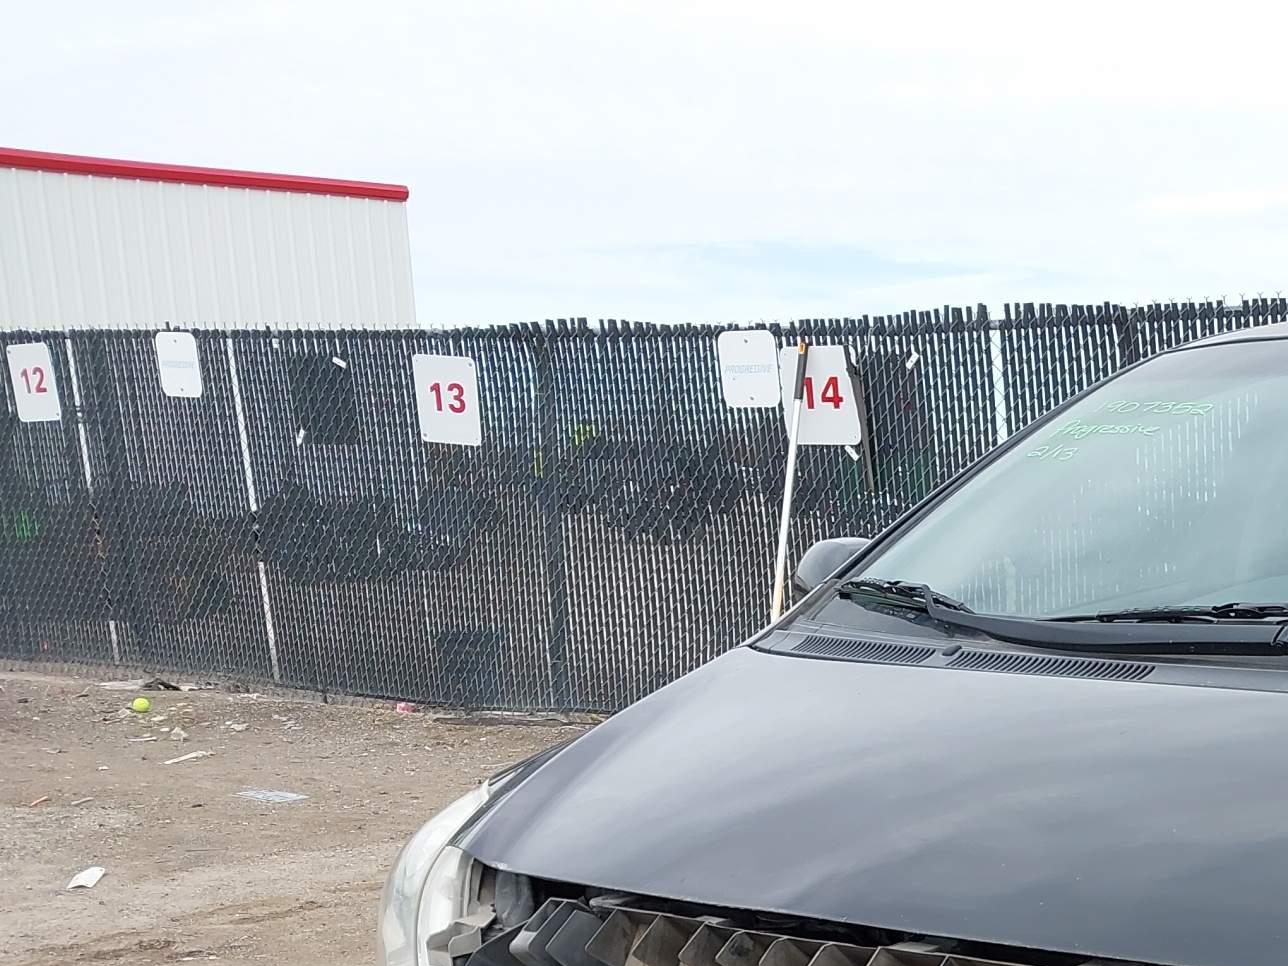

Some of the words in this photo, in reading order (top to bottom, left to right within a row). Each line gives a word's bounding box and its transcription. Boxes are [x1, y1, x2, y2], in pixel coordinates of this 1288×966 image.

[20, 366, 48, 395] 12
[803, 376, 843, 409] 14
[429, 382, 466, 414] 13
